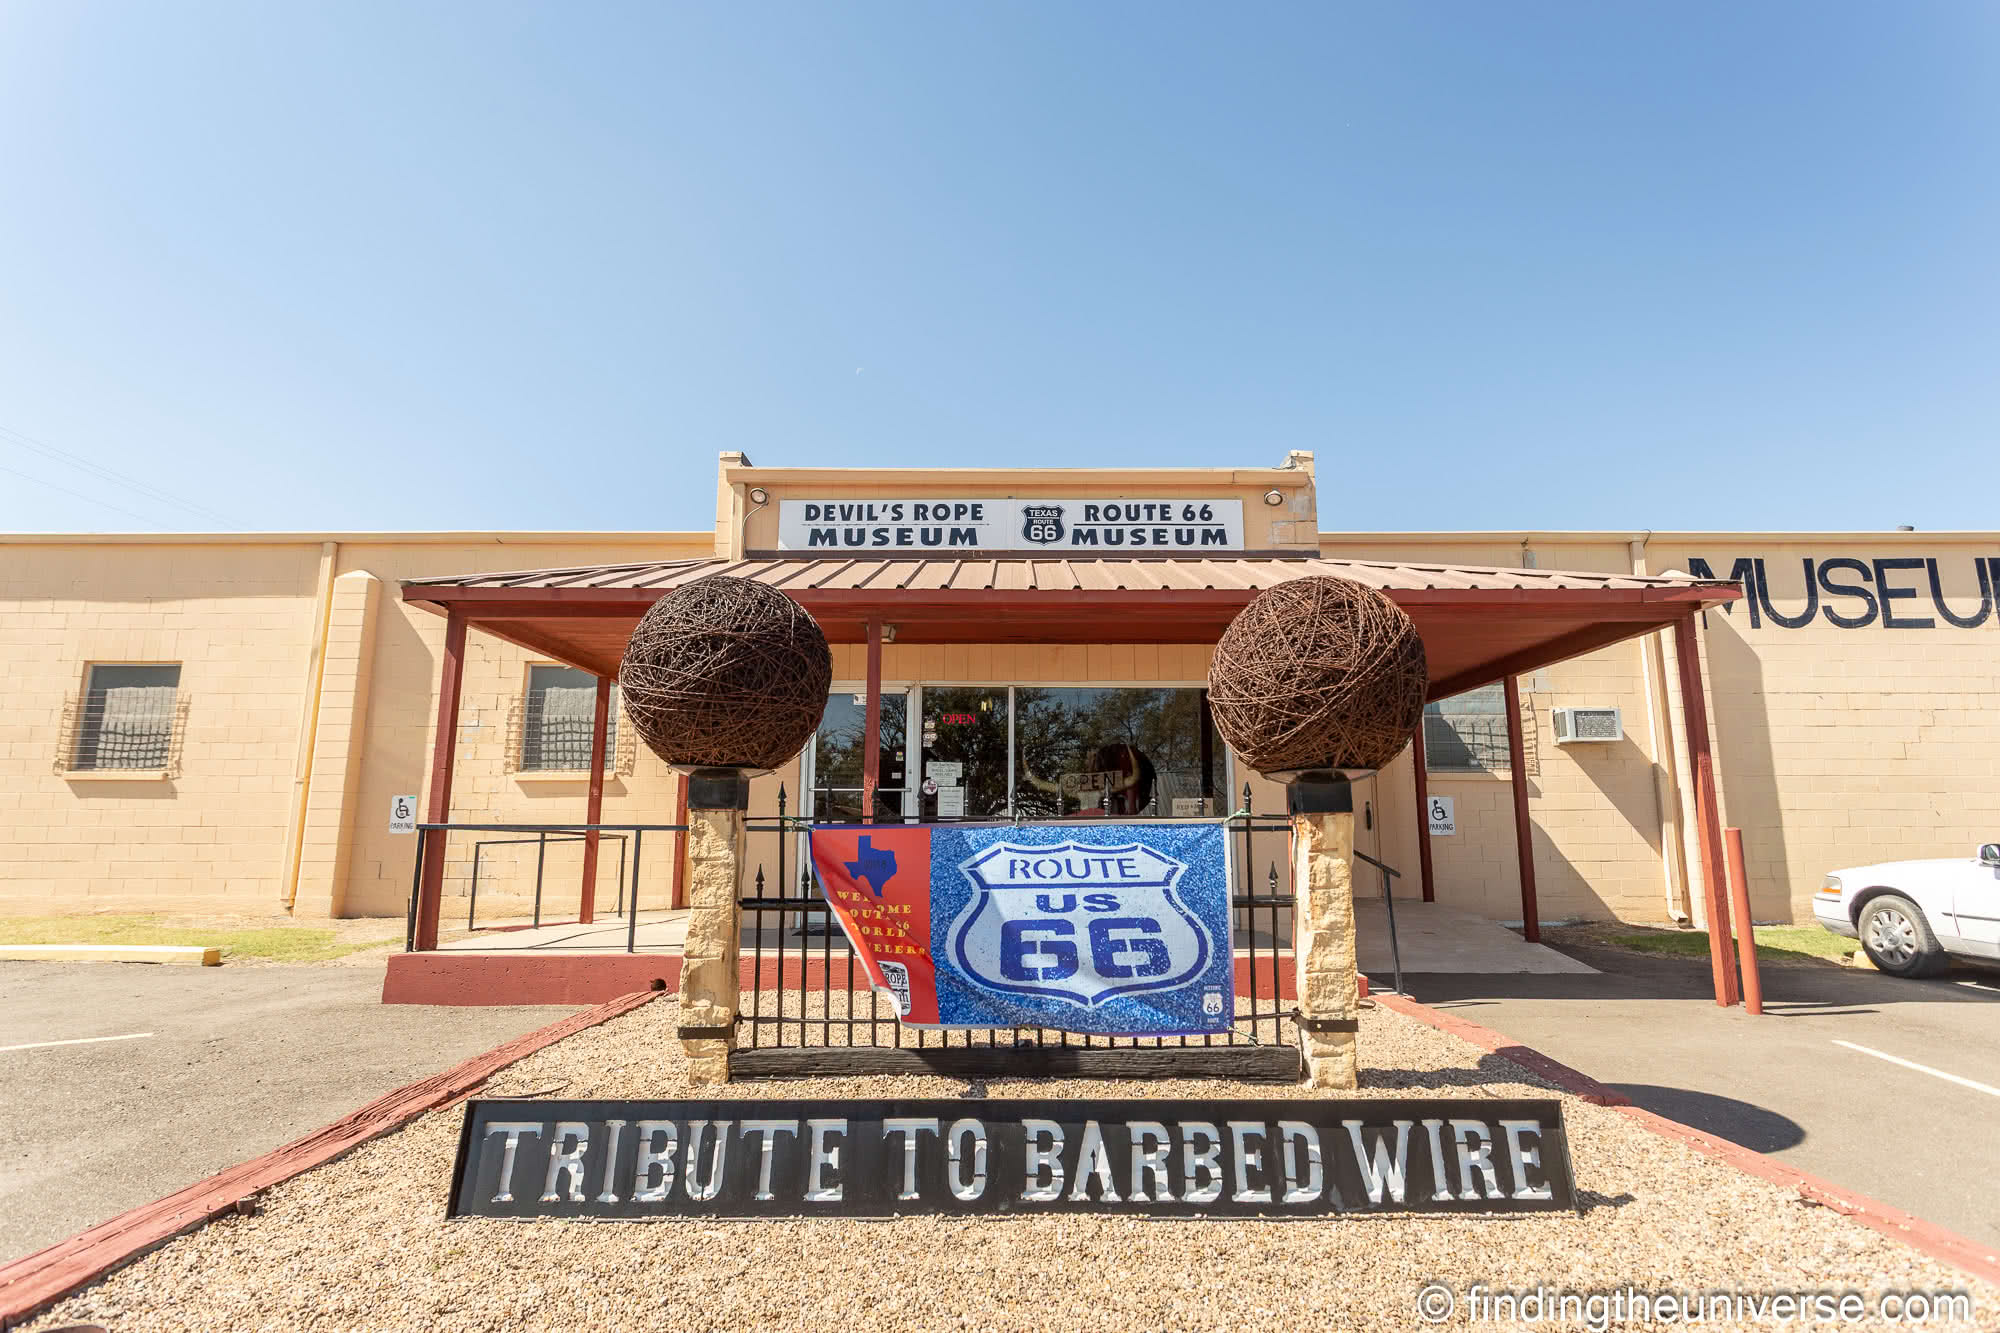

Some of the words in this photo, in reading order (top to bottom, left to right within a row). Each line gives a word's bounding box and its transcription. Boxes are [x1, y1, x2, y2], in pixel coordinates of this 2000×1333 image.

[805, 503, 904, 521] DEVIL'S
[914, 503, 984, 521] ROPE
[1029, 509, 1058, 517] TEXAS
[1084, 504, 1172, 521] ROUTE
[1182, 503, 1214, 521] 66
[808, 527, 978, 546] MUSEUM
[1030, 525, 1057, 540] 66
[1072, 528, 1228, 546] MUSEUM
[1688, 557, 2000, 630] MUSEU
[942, 713, 976, 725] OPEN
[1065, 771, 1116, 792] OPEN
[391, 822, 414, 830] PARKING
[1429, 823, 1454, 831] PARKING
[1009, 857, 1141, 880] ROUTE
[1036, 893, 1121, 914] US
[1000, 917, 1172, 982] 66
[1206, 1002, 1220, 1013] 66
[484, 1119, 848, 1202] TRIBUTE
[882, 1117, 988, 1202] TO
[1021, 1118, 1324, 1202] BARBED
[1341, 1119, 1554, 1203] WIRE
